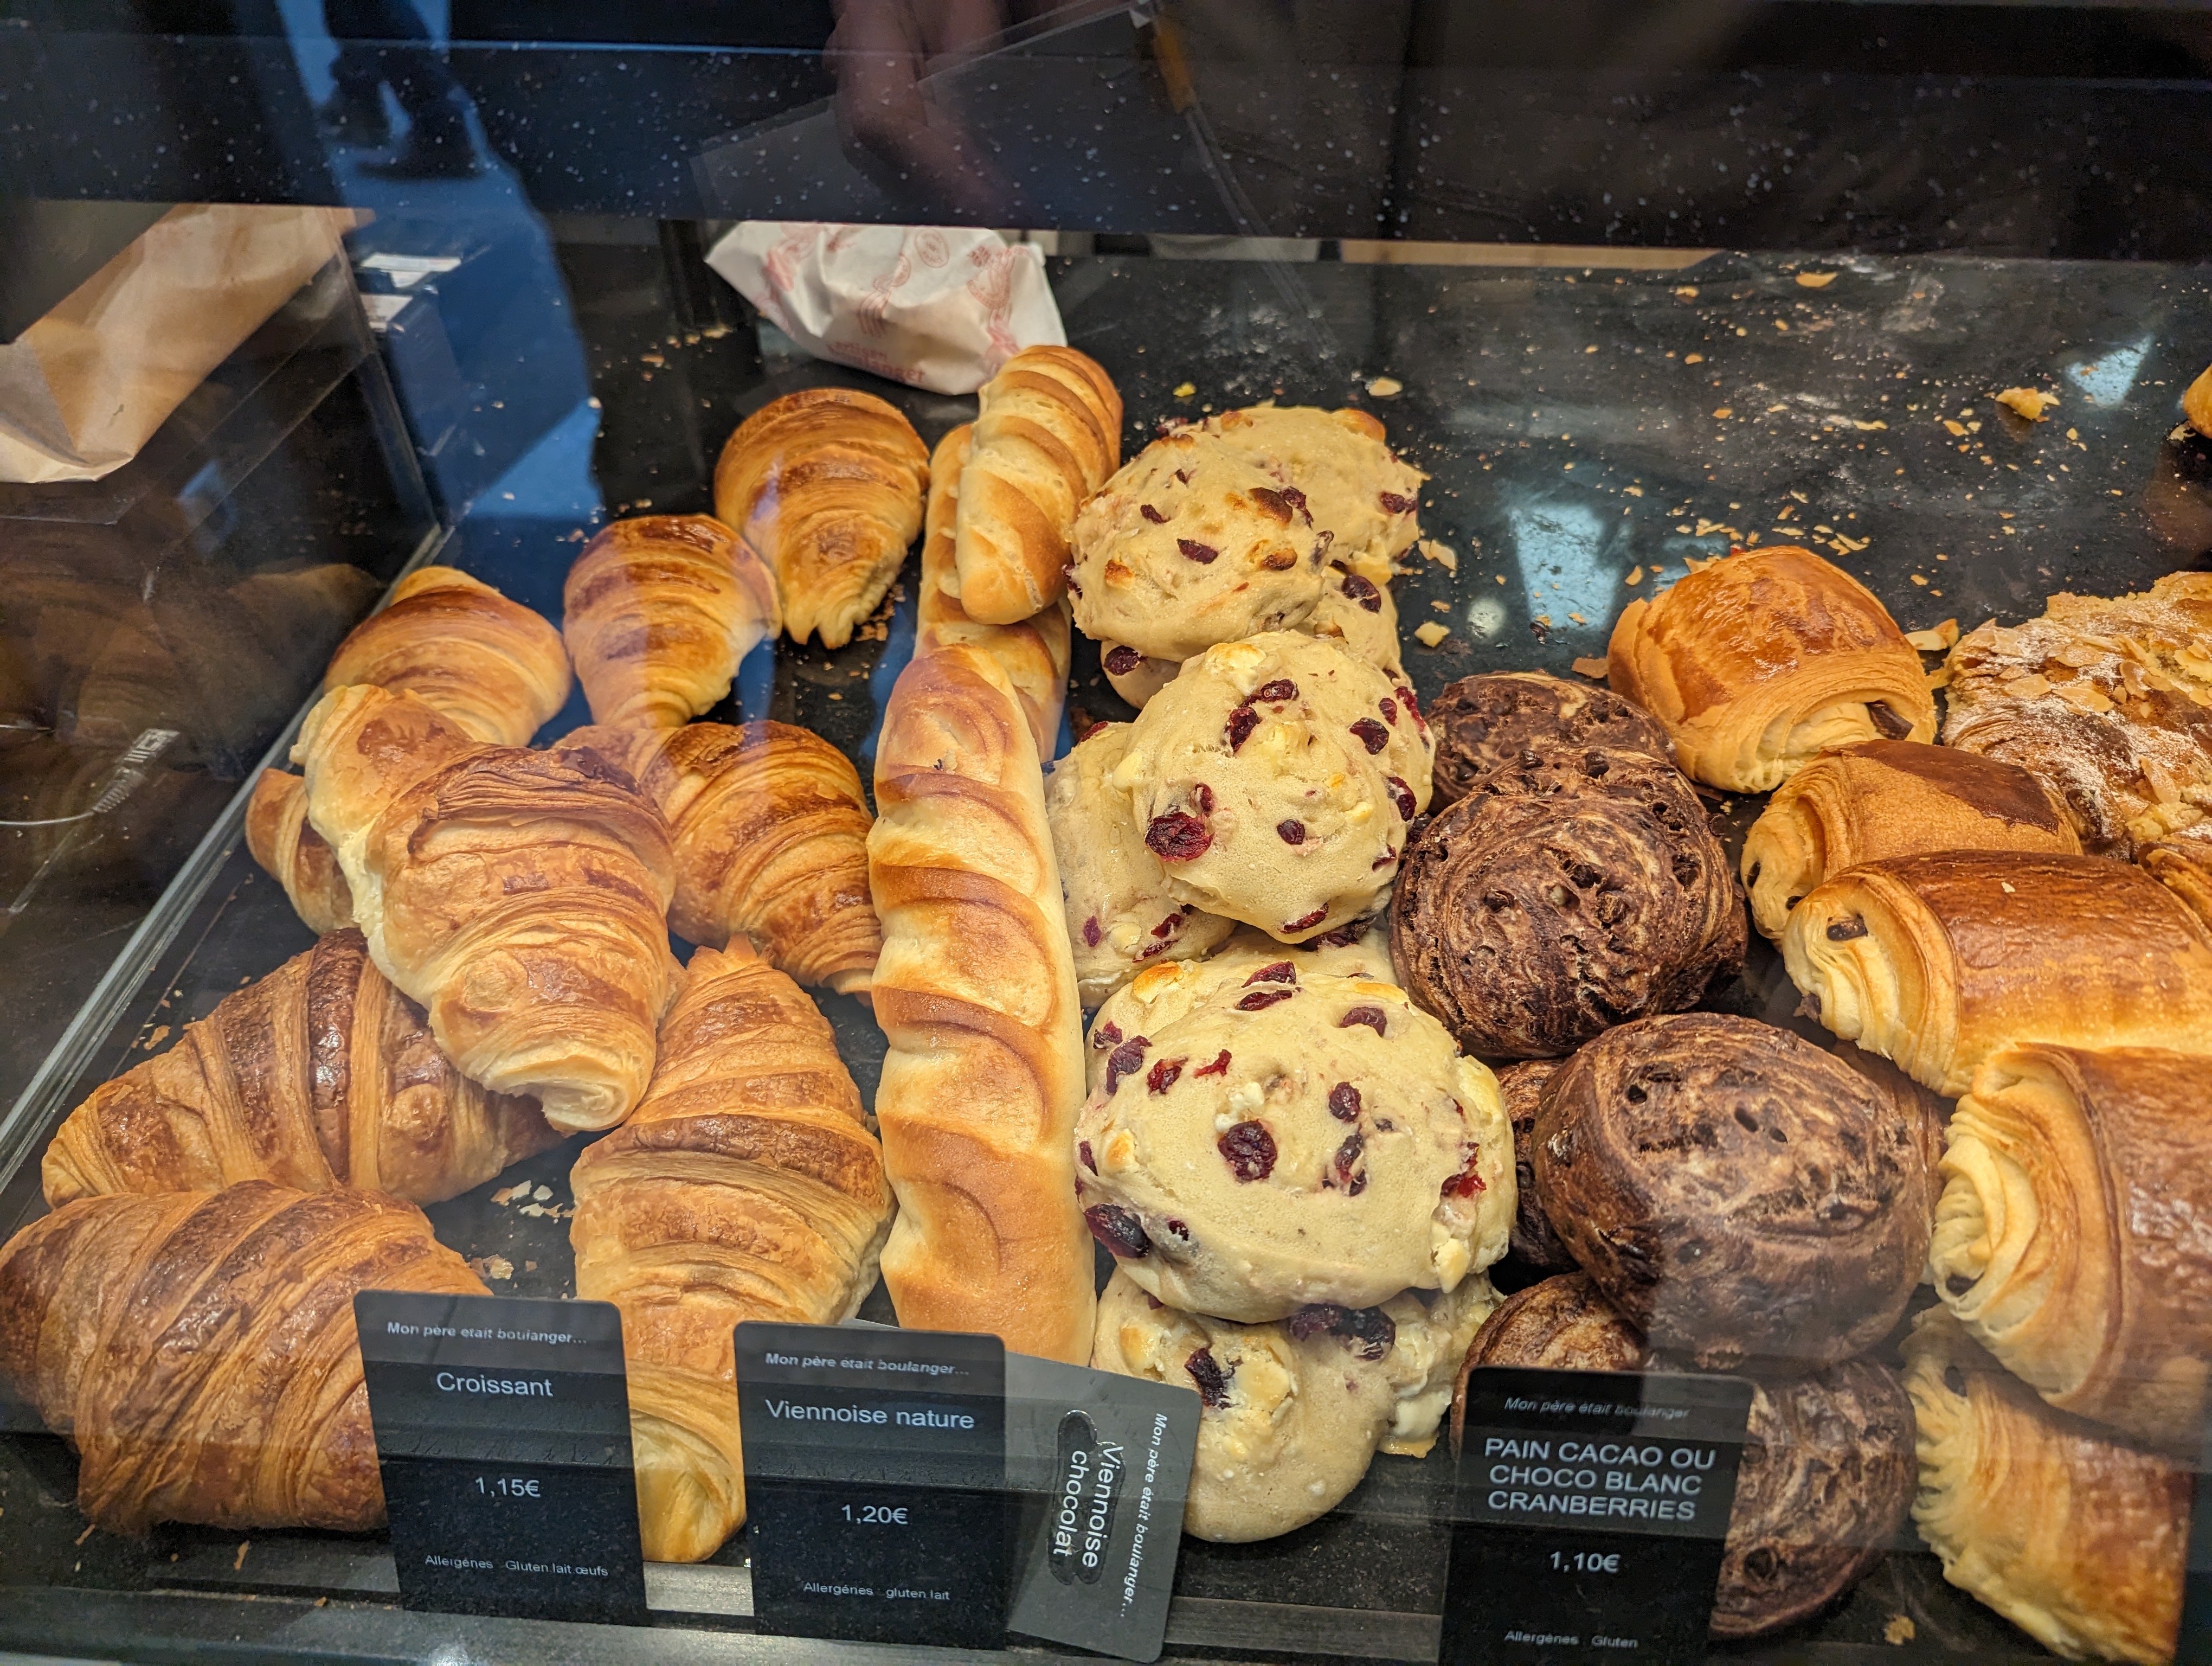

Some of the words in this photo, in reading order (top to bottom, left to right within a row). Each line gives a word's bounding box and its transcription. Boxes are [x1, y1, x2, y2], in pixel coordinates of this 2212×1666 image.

[387, 1322, 419, 1335] Mon
[423, 1325, 455, 1337] père
[766, 1353, 799, 1366] Mon
[802, 1356, 836, 1368] père
[436, 1372, 553, 1397] Croissant
[765, 1399, 888, 1424] Viennoise
[896, 1408, 975, 1429] nature
[1504, 1397, 1536, 1411] Mon
[1151, 1413, 1167, 1446] Mon
[1145, 1447, 1160, 1483] père
[1484, 1438, 1549, 1460] PAIN
[1558, 1442, 1663, 1466] CACAO
[1670, 1448, 1716, 1470] OU
[475, 1477, 541, 1498] 1,15€
[1489, 1465, 1597, 1489] CHOCO
[1605, 1471, 1702, 1495] BLANC
[841, 1504, 908, 1525] 1,20€
[1053, 1450, 1090, 1557] chocolat
[1082, 1445, 1124, 1568] Viennoise
[1138, 1486, 1153, 1521] était
[1488, 1491, 1696, 1521] CRANBERRIES
[1550, 1551, 1621, 1573] 1,10€
[885, 1588, 926, 1599] gluten
[931, 1590, 950, 1600] lait
[1591, 1635, 1639, 1649] Gluten
